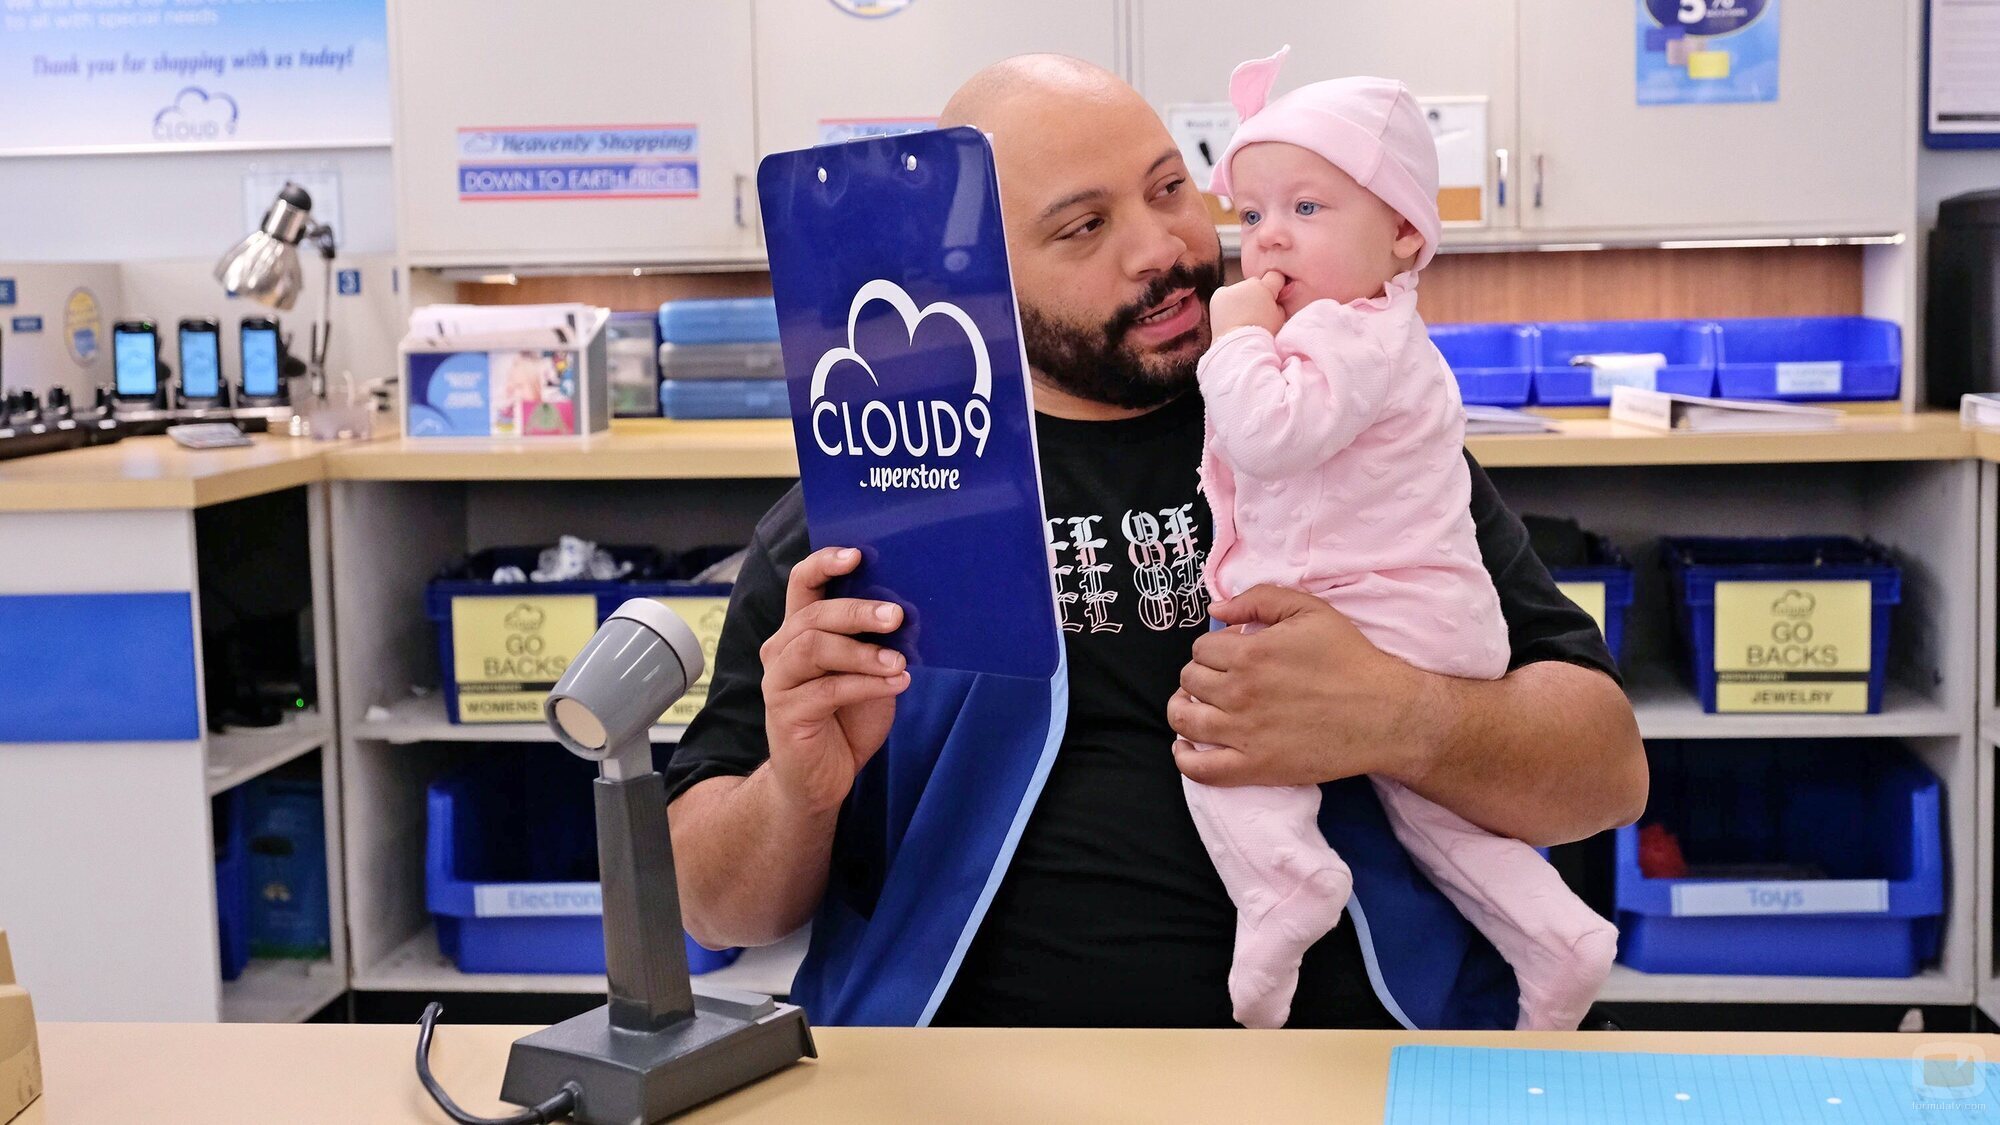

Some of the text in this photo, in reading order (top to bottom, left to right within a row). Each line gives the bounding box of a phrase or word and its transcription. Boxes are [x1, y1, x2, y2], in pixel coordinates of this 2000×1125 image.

[32, 46, 355, 79] Thank you for shopping with us today!
[501, 131, 694, 154] Heavenly Shopping
[464, 167, 695, 192] DOWN TO EARTH PRICES
[812, 399, 992, 458] CLOUD9
[859, 463, 961, 492] uperstore
[1771, 621, 1814, 644] GO
[505, 634, 545, 656] GO
[1746, 644, 1839, 667] BACKS
[483, 656, 567, 679] BACKS
[1752, 690, 1834, 705] JEWELRY
[507, 890, 601, 909] Electron
[1747, 888, 1805, 912] Toys
